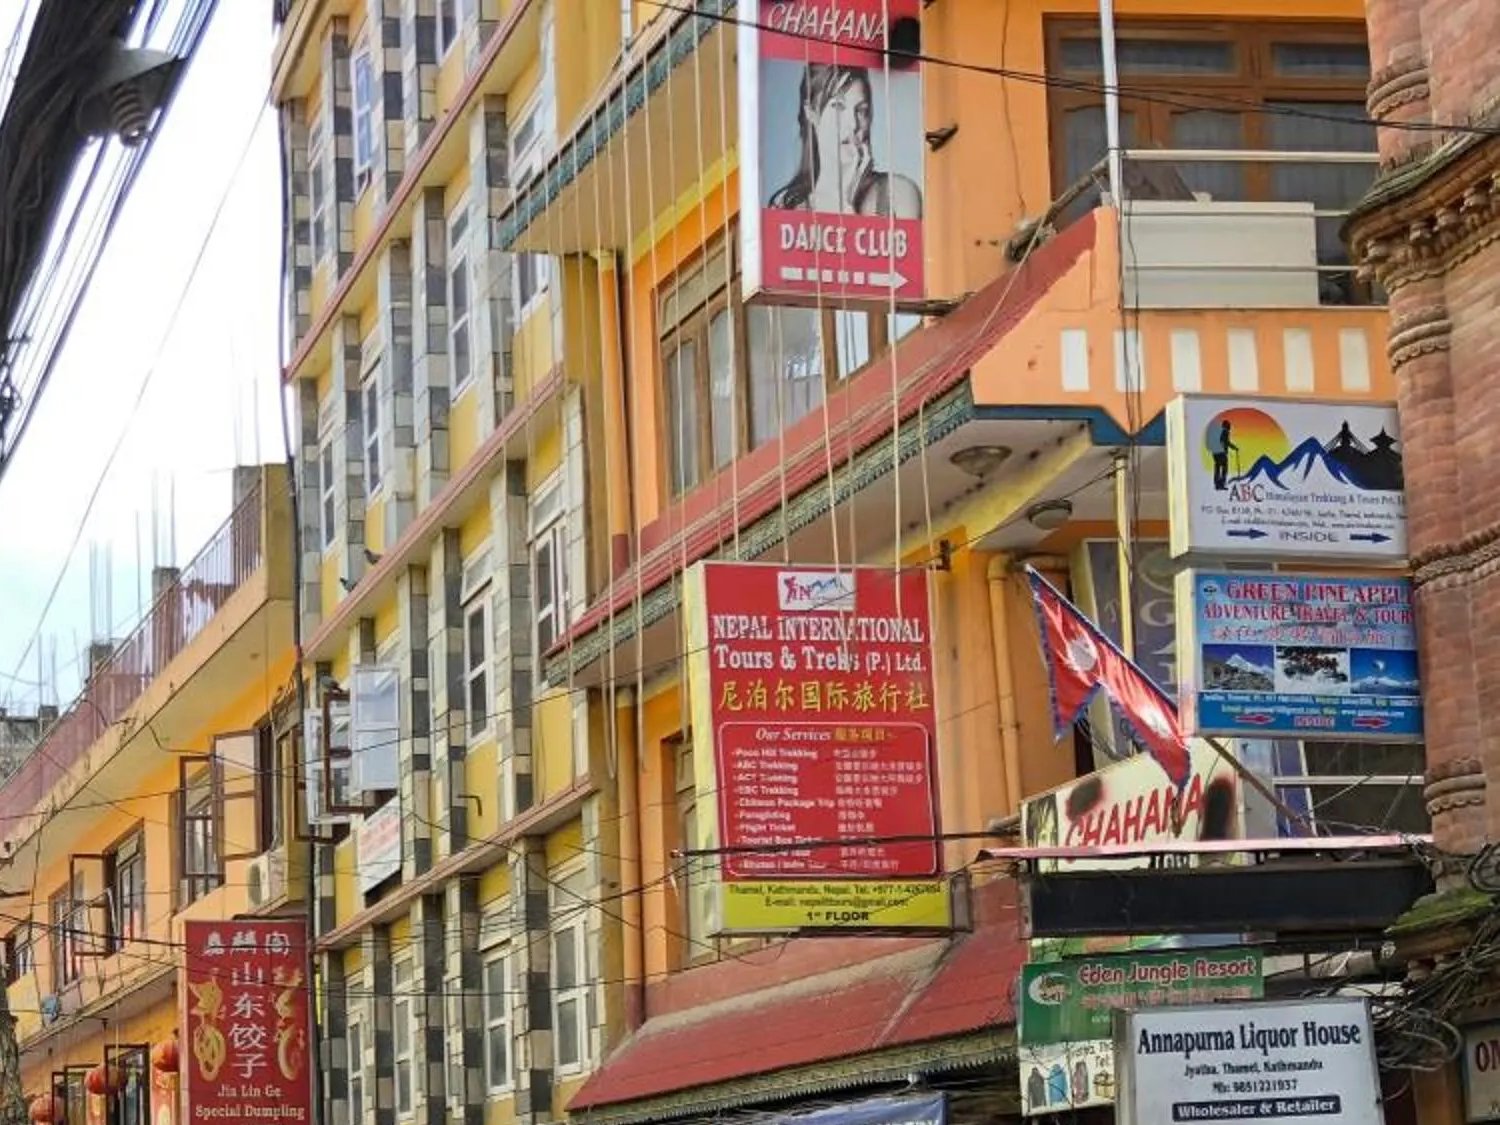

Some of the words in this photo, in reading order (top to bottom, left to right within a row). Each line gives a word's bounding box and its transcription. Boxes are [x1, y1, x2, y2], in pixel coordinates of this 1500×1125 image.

[766, 3, 888, 41] CHAHANA
[780, 223, 847, 254] DANCE
[854, 227, 908, 258] CLUB
[713, 615, 772, 640] NEPAL
[777, 614, 925, 643] INTERNATIONAL
[714, 645, 773, 671] Tours
[780, 647, 796, 671] &
[896, 653, 926, 673] Ltd.
[719, 679, 930, 713] 尼泊尔国际旅行社
[782, 727, 831, 741] Services
[825, 911, 869, 922] FLOOR
[1077, 964, 1124, 985] Eden
[1129, 960, 1189, 985] Jungle
[1193, 957, 1255, 978] Resort
[228, 961, 268, 1079] 山东饺子
[1138, 1027, 1235, 1059] Annapurna
[1240, 1022, 1298, 1056] Liquor
[1303, 1021, 1361, 1045] House
[241, 1083, 261, 1098] Lin
[195, 1104, 241, 1120] Special
[244, 1104, 305, 1121] Dumpling
[1177, 1102, 1256, 1118] Wholesaler
[1260, 1102, 1273, 1114] &
[1278, 1098, 1335, 1114] Retailer
